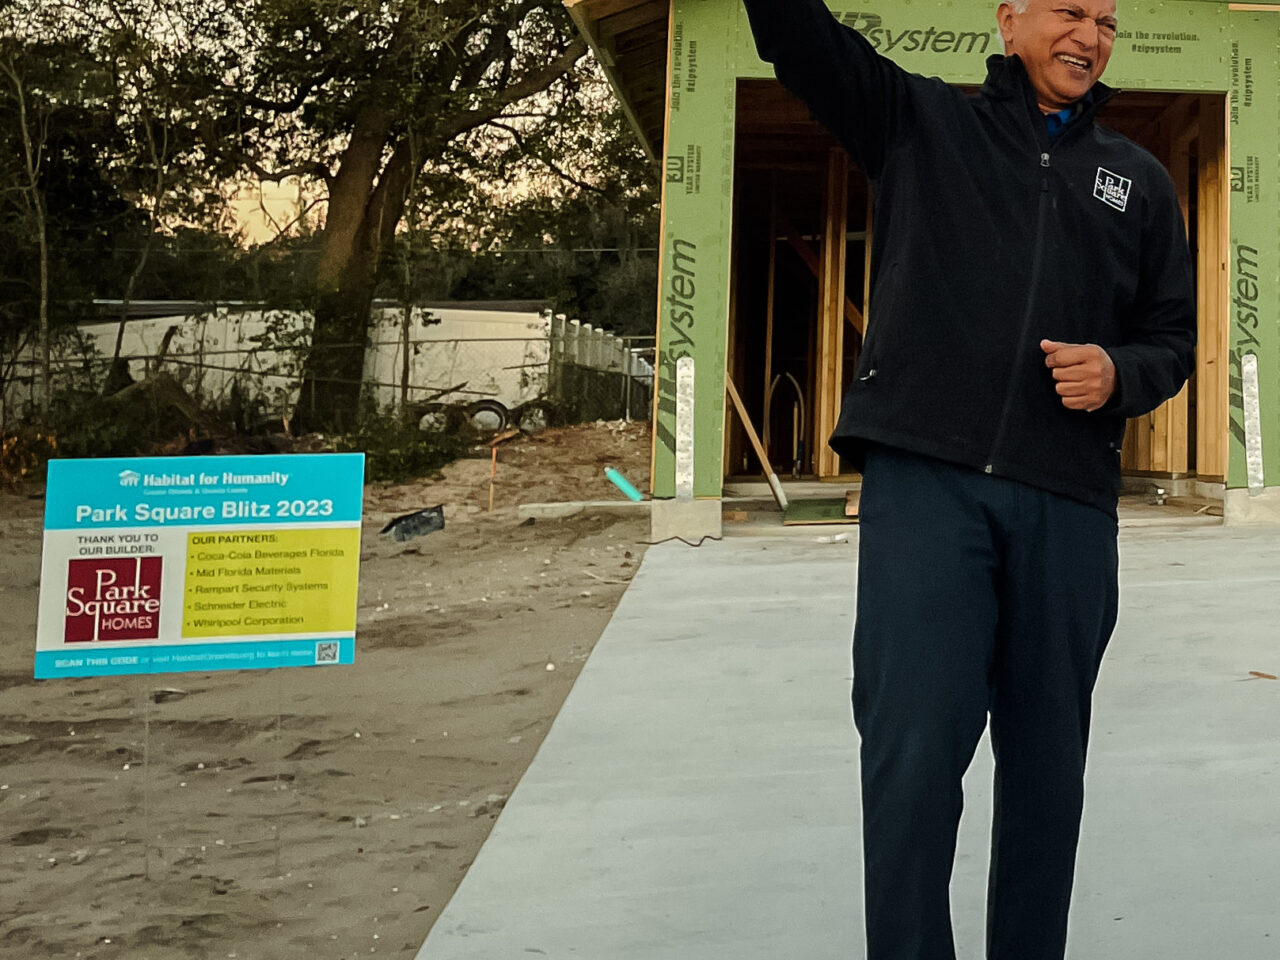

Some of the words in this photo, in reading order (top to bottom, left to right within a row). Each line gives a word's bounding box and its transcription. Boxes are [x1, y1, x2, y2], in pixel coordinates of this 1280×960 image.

[830, 11, 991, 54] Psystem
[1136, 31, 1149, 39] the
[1132, 44, 1182, 54] #zipsystem
[143, 473, 195, 486] Habitat
[199, 474, 219, 485] for
[222, 472, 289, 486] Humanity
[76, 504, 127, 523] Park
[135, 503, 216, 523] Square
[222, 500, 270, 518] Blitz
[276, 499, 333, 517] 2023
[78, 535, 115, 543] THANK
[118, 534, 141, 543] YOU
[144, 534, 158, 542] TO
[192, 536, 216, 545] OUR
[218, 535, 278, 544] PARTNERS:
[79, 547, 102, 555] OUR
[197, 551, 252, 561] Coca-Cola
[255, 549, 307, 559] Beverages
[310, 548, 344, 557] Florida
[196, 569, 215, 577] Mid
[218, 568, 252, 577] Florida
[255, 567, 301, 575] Materials
[195, 585, 239, 595] Rampart
[242, 583, 283, 592] Security
[286, 582, 328, 591] Systems
[194, 600, 245, 611] Schneider
[249, 599, 287, 609] Electric
[102, 616, 152, 630] HOMES
[193, 618, 242, 628] Whirlpool
[244, 615, 304, 626] Corporation
